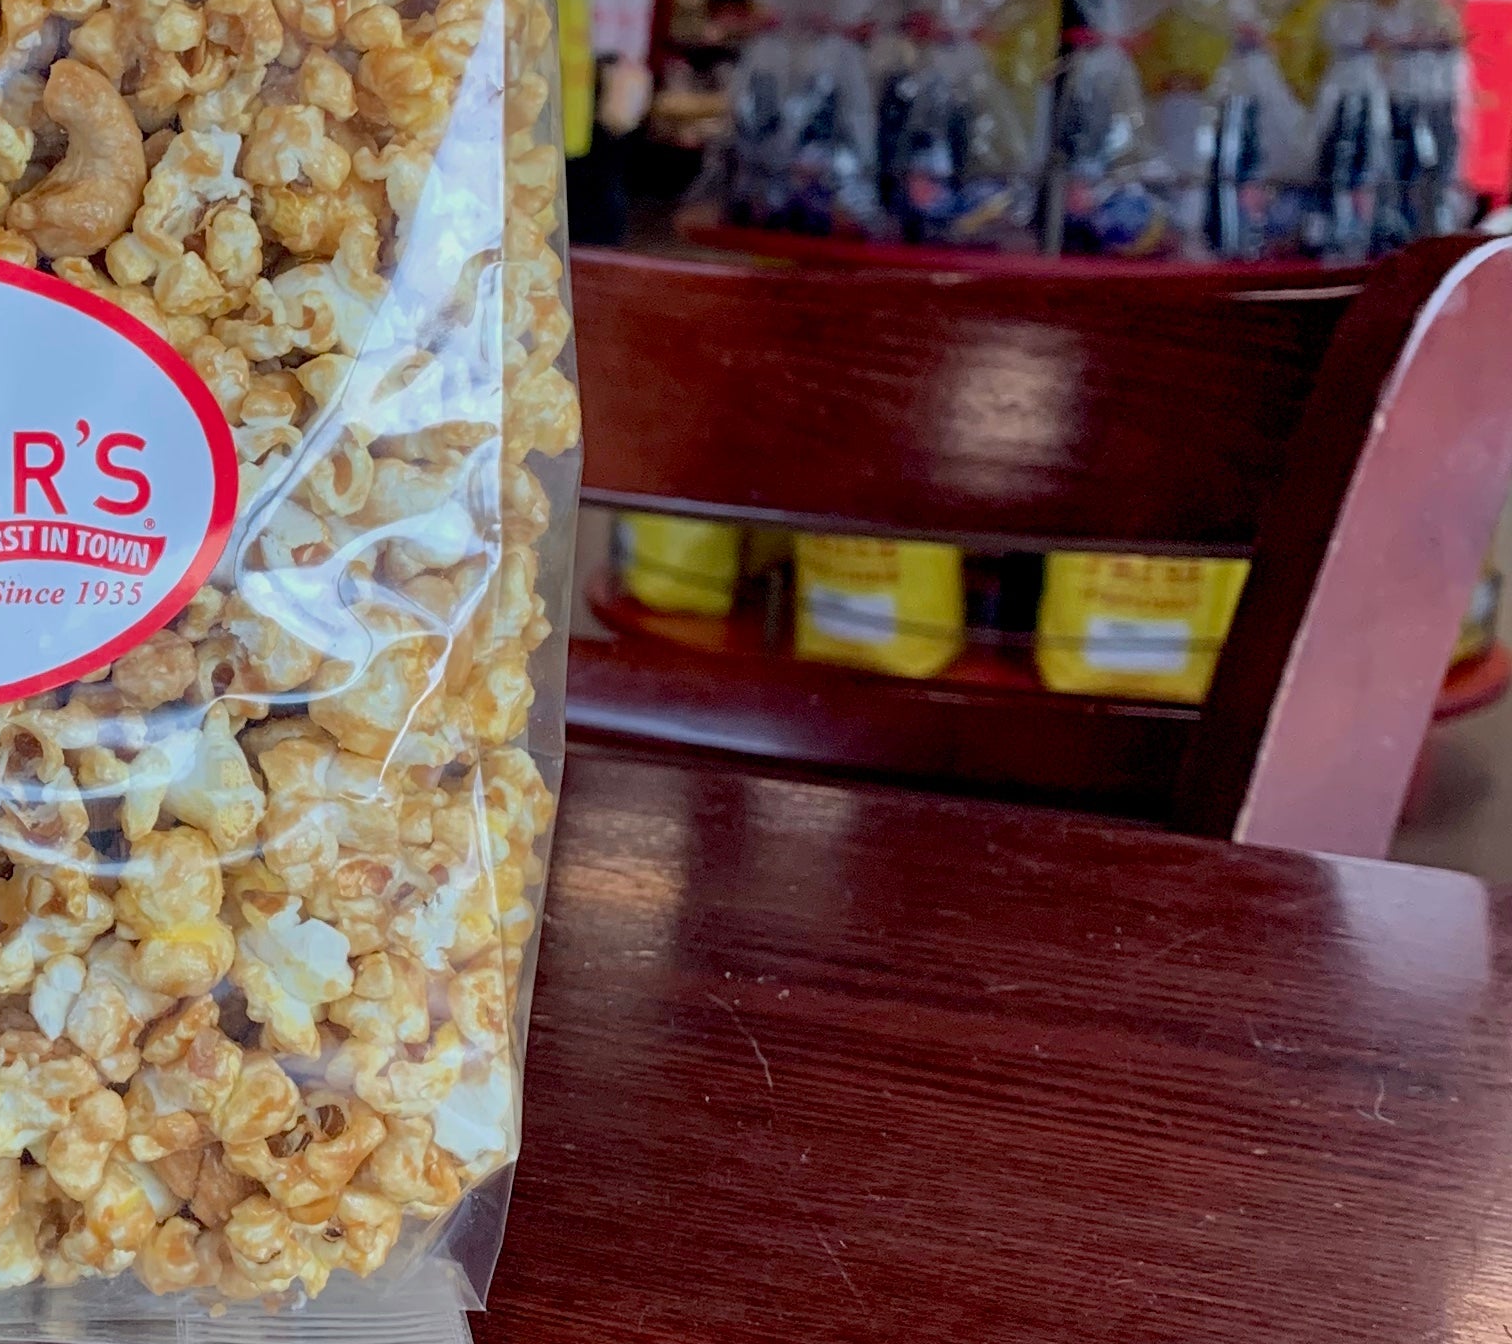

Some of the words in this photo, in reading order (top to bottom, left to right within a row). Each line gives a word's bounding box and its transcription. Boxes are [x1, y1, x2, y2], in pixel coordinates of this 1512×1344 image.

[40, 525, 70, 554] IN
[76, 528, 150, 569] TOWN
[74, 579, 144, 606] 1935
